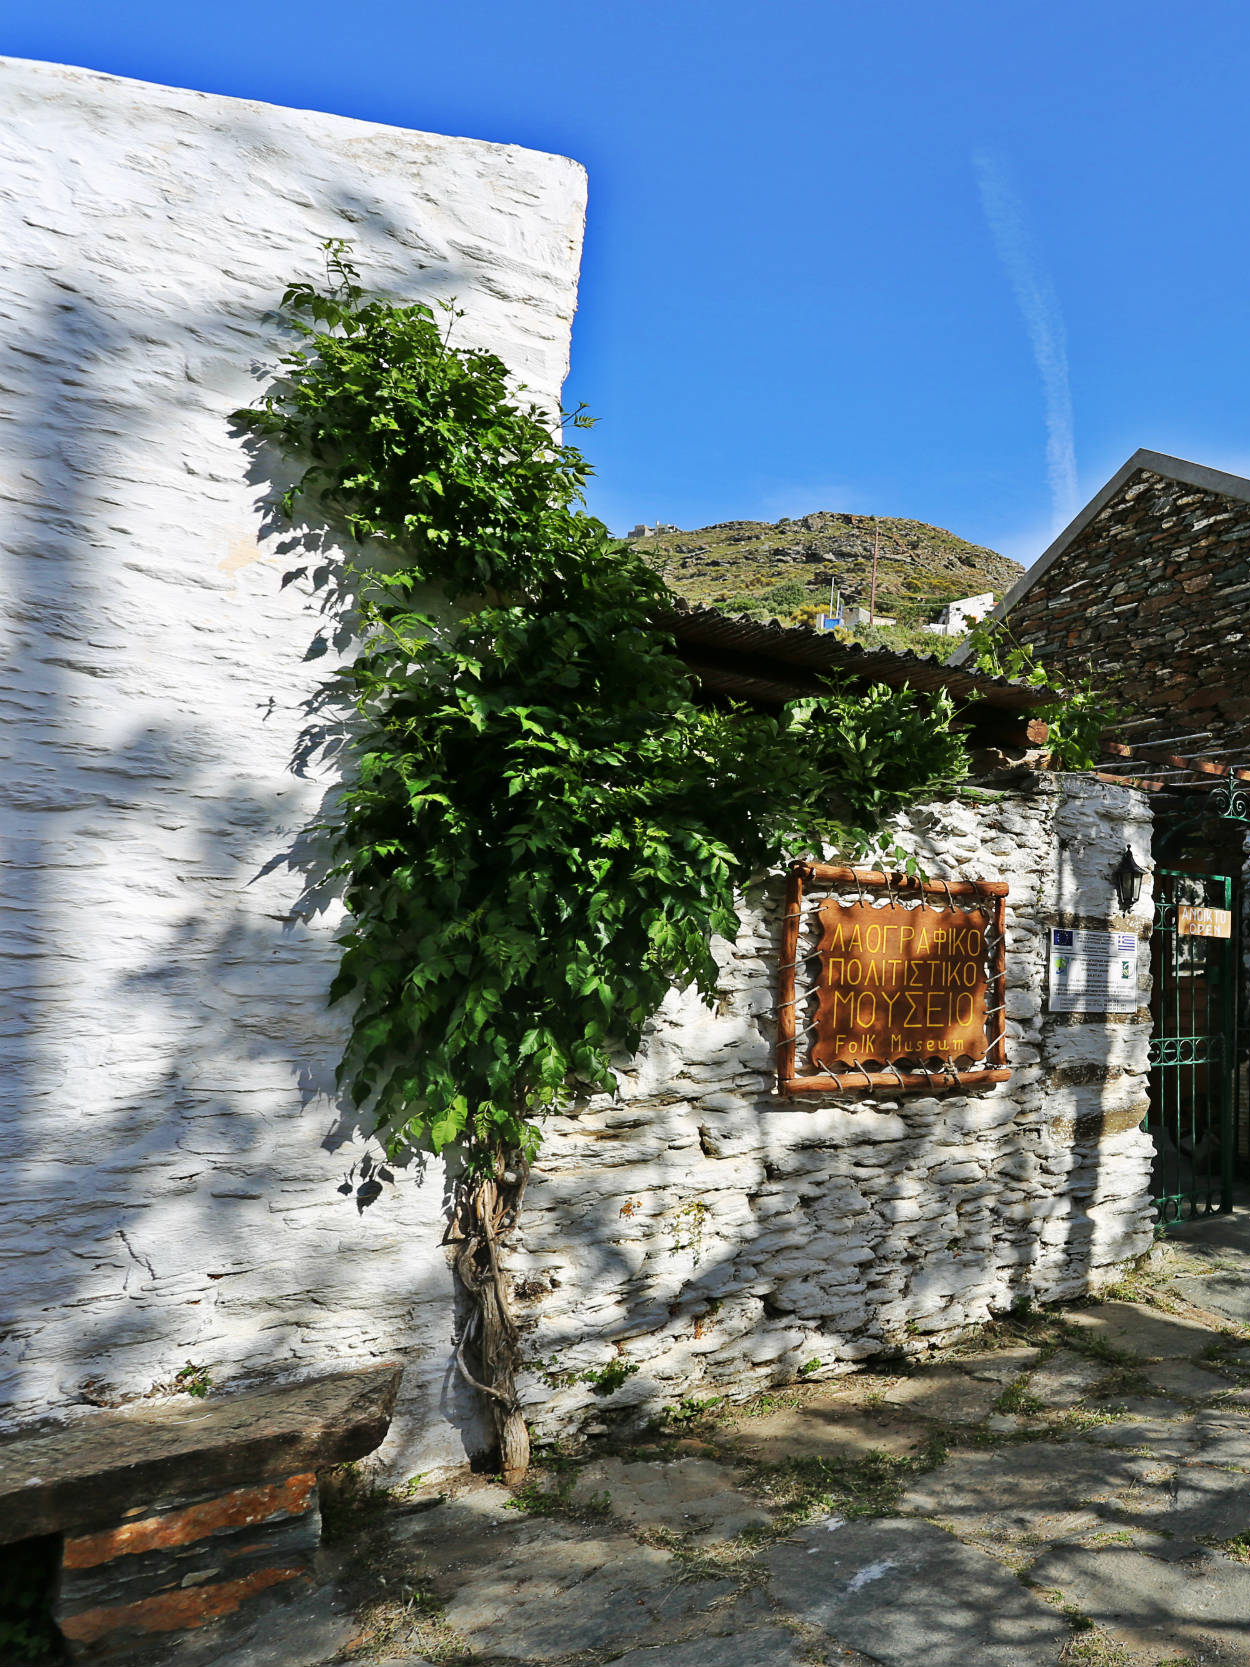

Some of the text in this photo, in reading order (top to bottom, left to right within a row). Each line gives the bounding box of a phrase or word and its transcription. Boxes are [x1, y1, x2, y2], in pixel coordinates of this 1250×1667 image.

[1182, 907, 1227, 924] ΑΝΟΙΚΤΟ
[831, 923, 981, 956] ΛΑΟΓΡΑΦΙΚΟ
[1189, 922, 1221, 936] OPEN
[828, 957, 977, 987] ΠΟΛΙΤΙΣΤΙΚΟ
[833, 991, 974, 1028] ΜΟΥΣΕΙΟ
[890, 1034, 964, 1052] Museum
